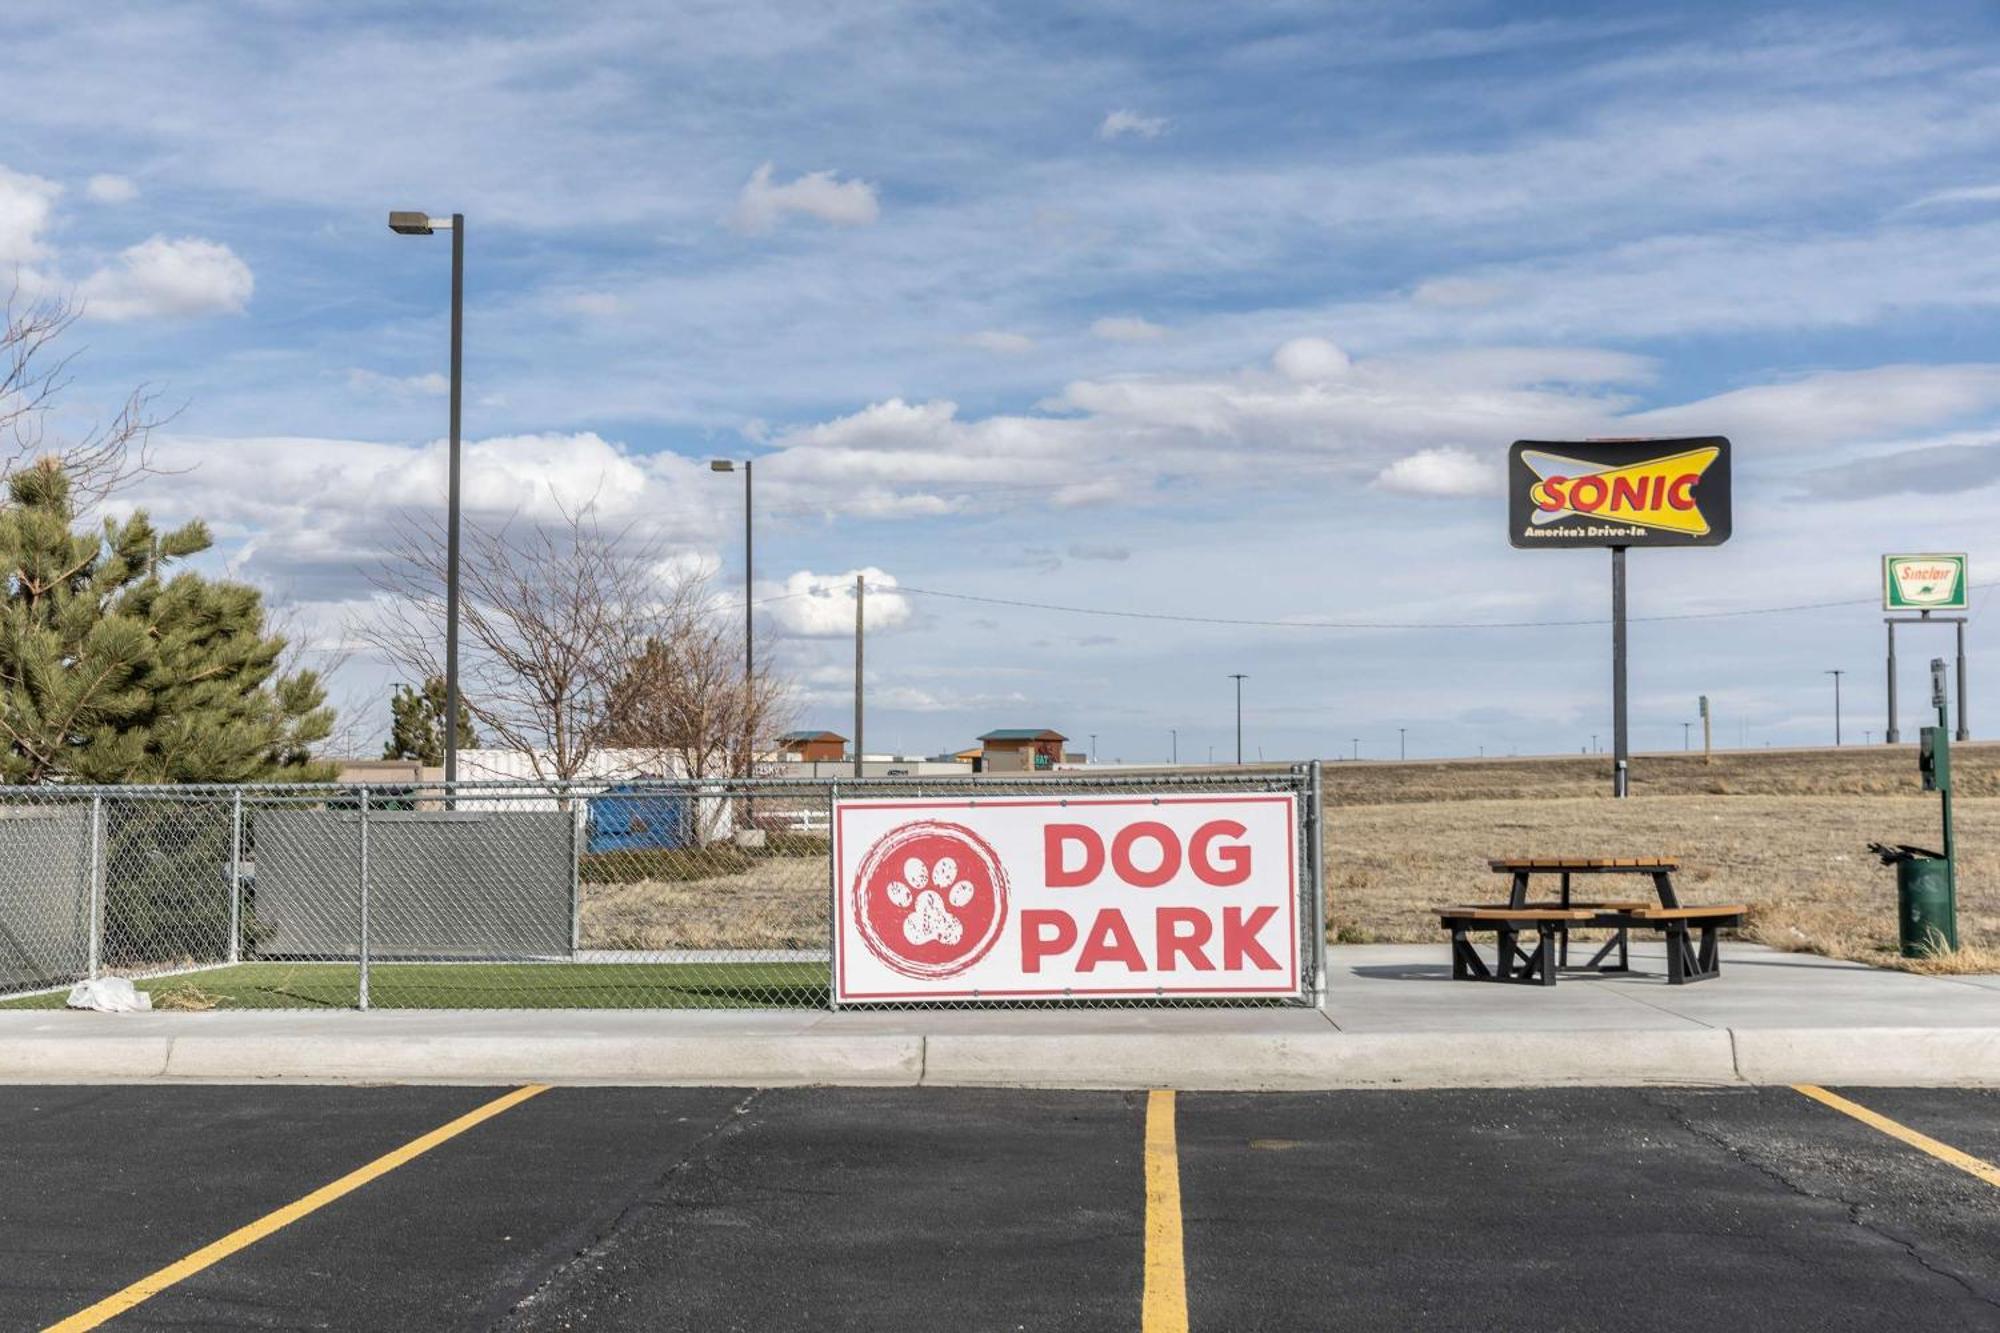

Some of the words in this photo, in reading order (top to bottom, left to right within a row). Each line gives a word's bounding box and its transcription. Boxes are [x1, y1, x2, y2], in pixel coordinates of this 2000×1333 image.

[1539, 474, 1701, 513] SONIC
[1524, 526, 1585, 537] America's
[1902, 566, 1951, 580] Sinclair
[1044, 819, 1251, 888] DOG
[1021, 906, 1283, 973] PARK
